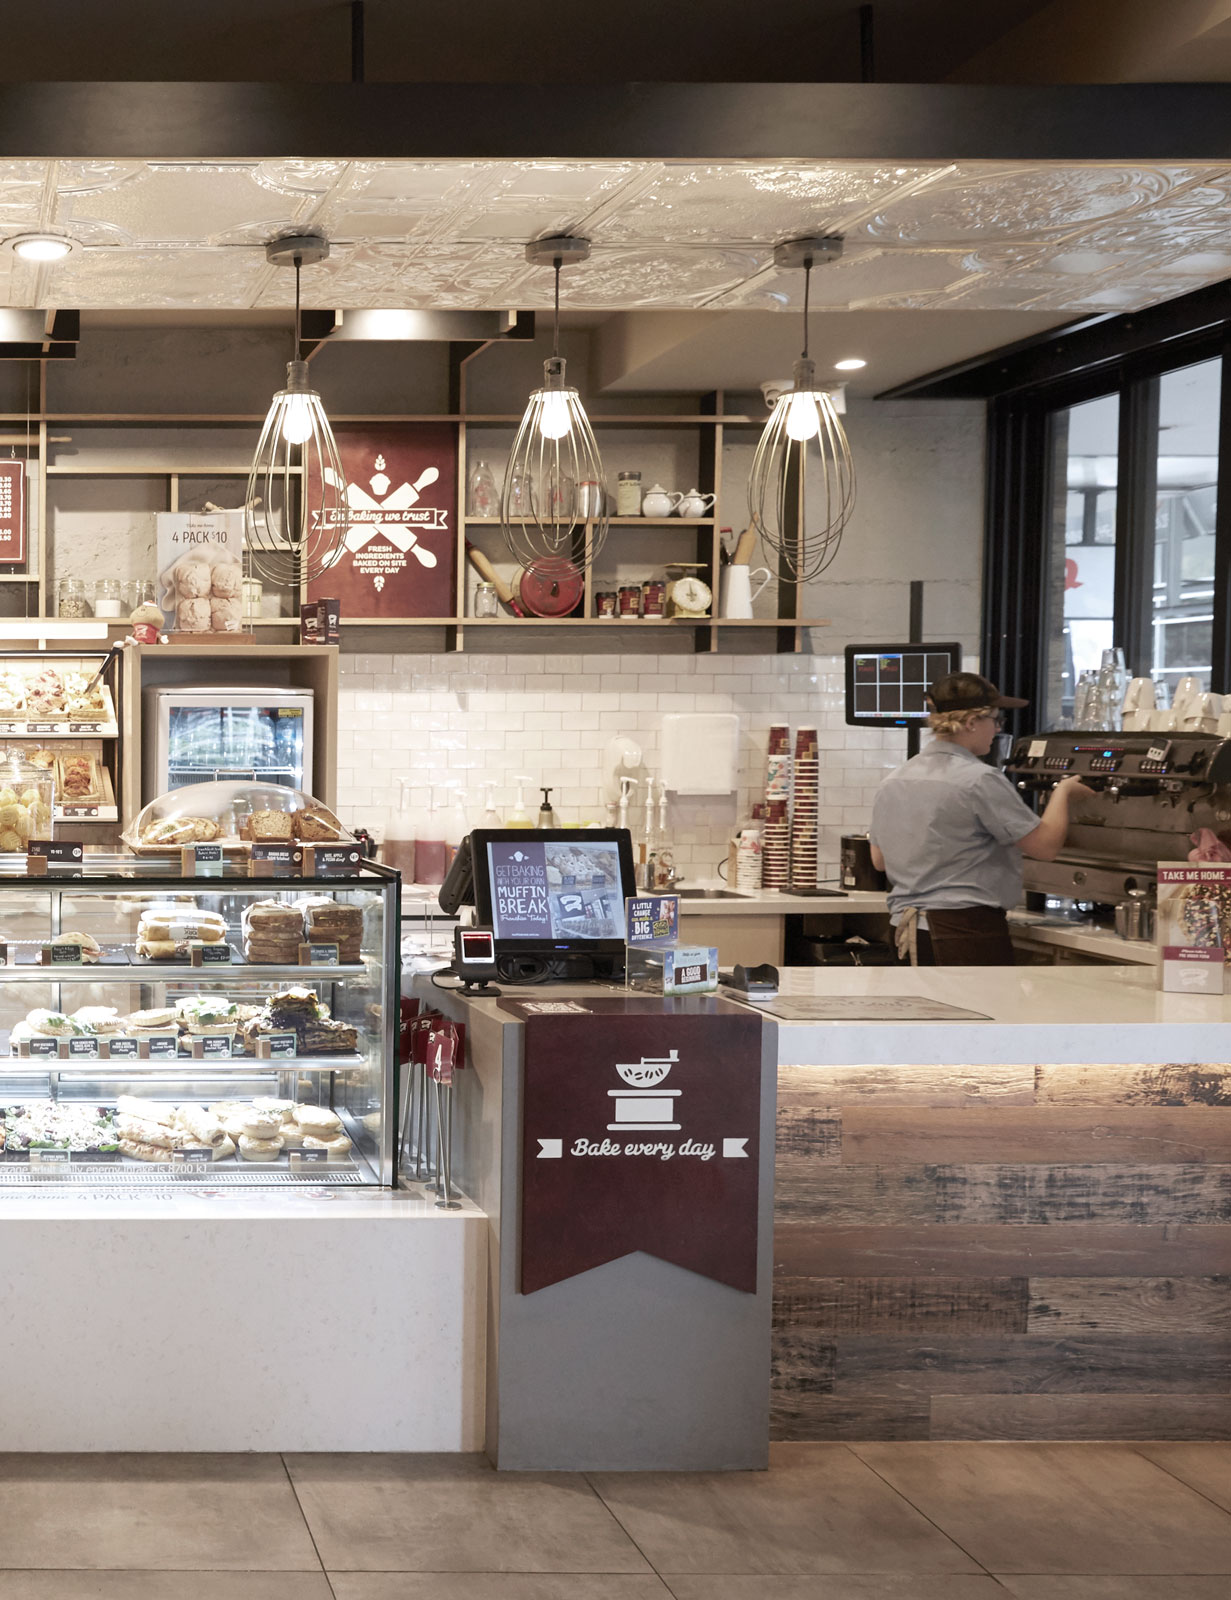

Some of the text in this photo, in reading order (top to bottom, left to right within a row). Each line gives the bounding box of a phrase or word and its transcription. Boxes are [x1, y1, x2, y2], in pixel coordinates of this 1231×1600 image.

[346, 509, 383, 524] baking
[384, 513, 400, 521] we
[402, 510, 430, 521] trust
[172, 532, 228, 544] 4 PACK $10
[496, 866, 544, 876] GET BAKING
[1163, 871, 1225, 880] TAKE ME HOME
[498, 886, 546, 897] MUFFIN
[499, 899, 547, 913] BREAK
[527, 914, 548, 923] Today!
[635, 922, 649, 934] BIG
[681, 966, 700, 976] A GOOD
[435, 1044, 442, 1071] 4
[571, 1138, 716, 1161] Bake every day
[169, 1164, 193, 1173] 8700
